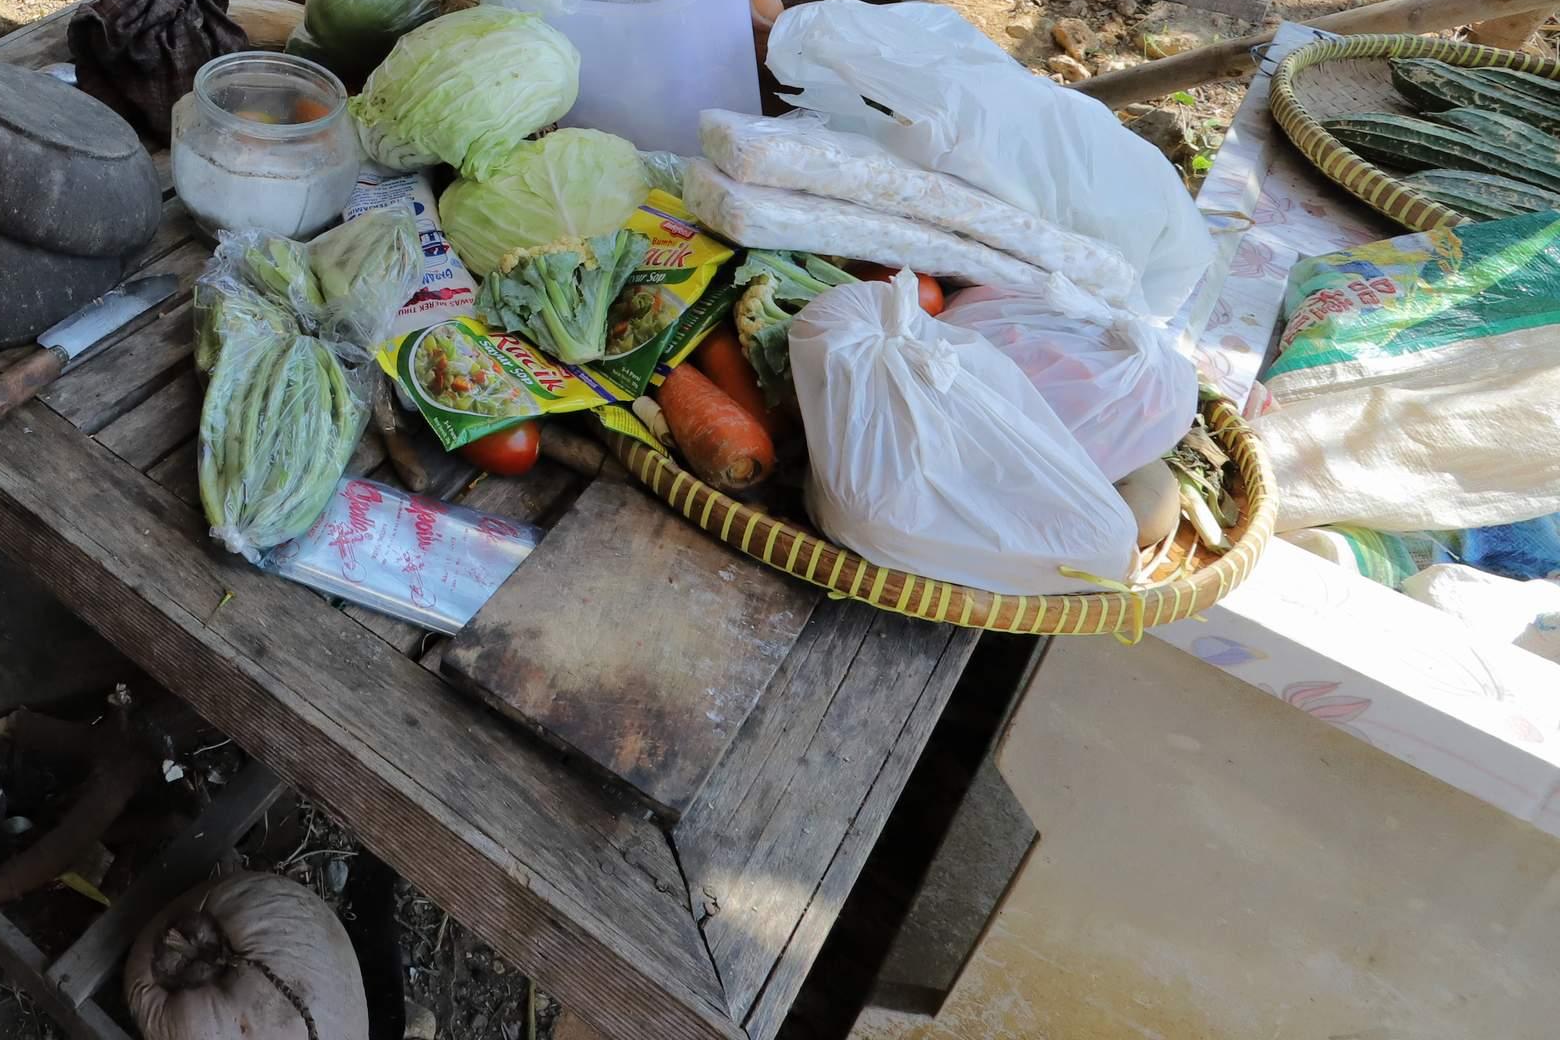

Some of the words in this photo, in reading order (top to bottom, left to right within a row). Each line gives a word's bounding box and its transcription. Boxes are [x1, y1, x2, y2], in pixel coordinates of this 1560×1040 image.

[644, 241, 692, 268] acik
[646, 272, 667, 284] Sop
[479, 340, 514, 369] Sayur
[509, 365, 534, 386] Sop
[487, 332, 566, 393] Racik
